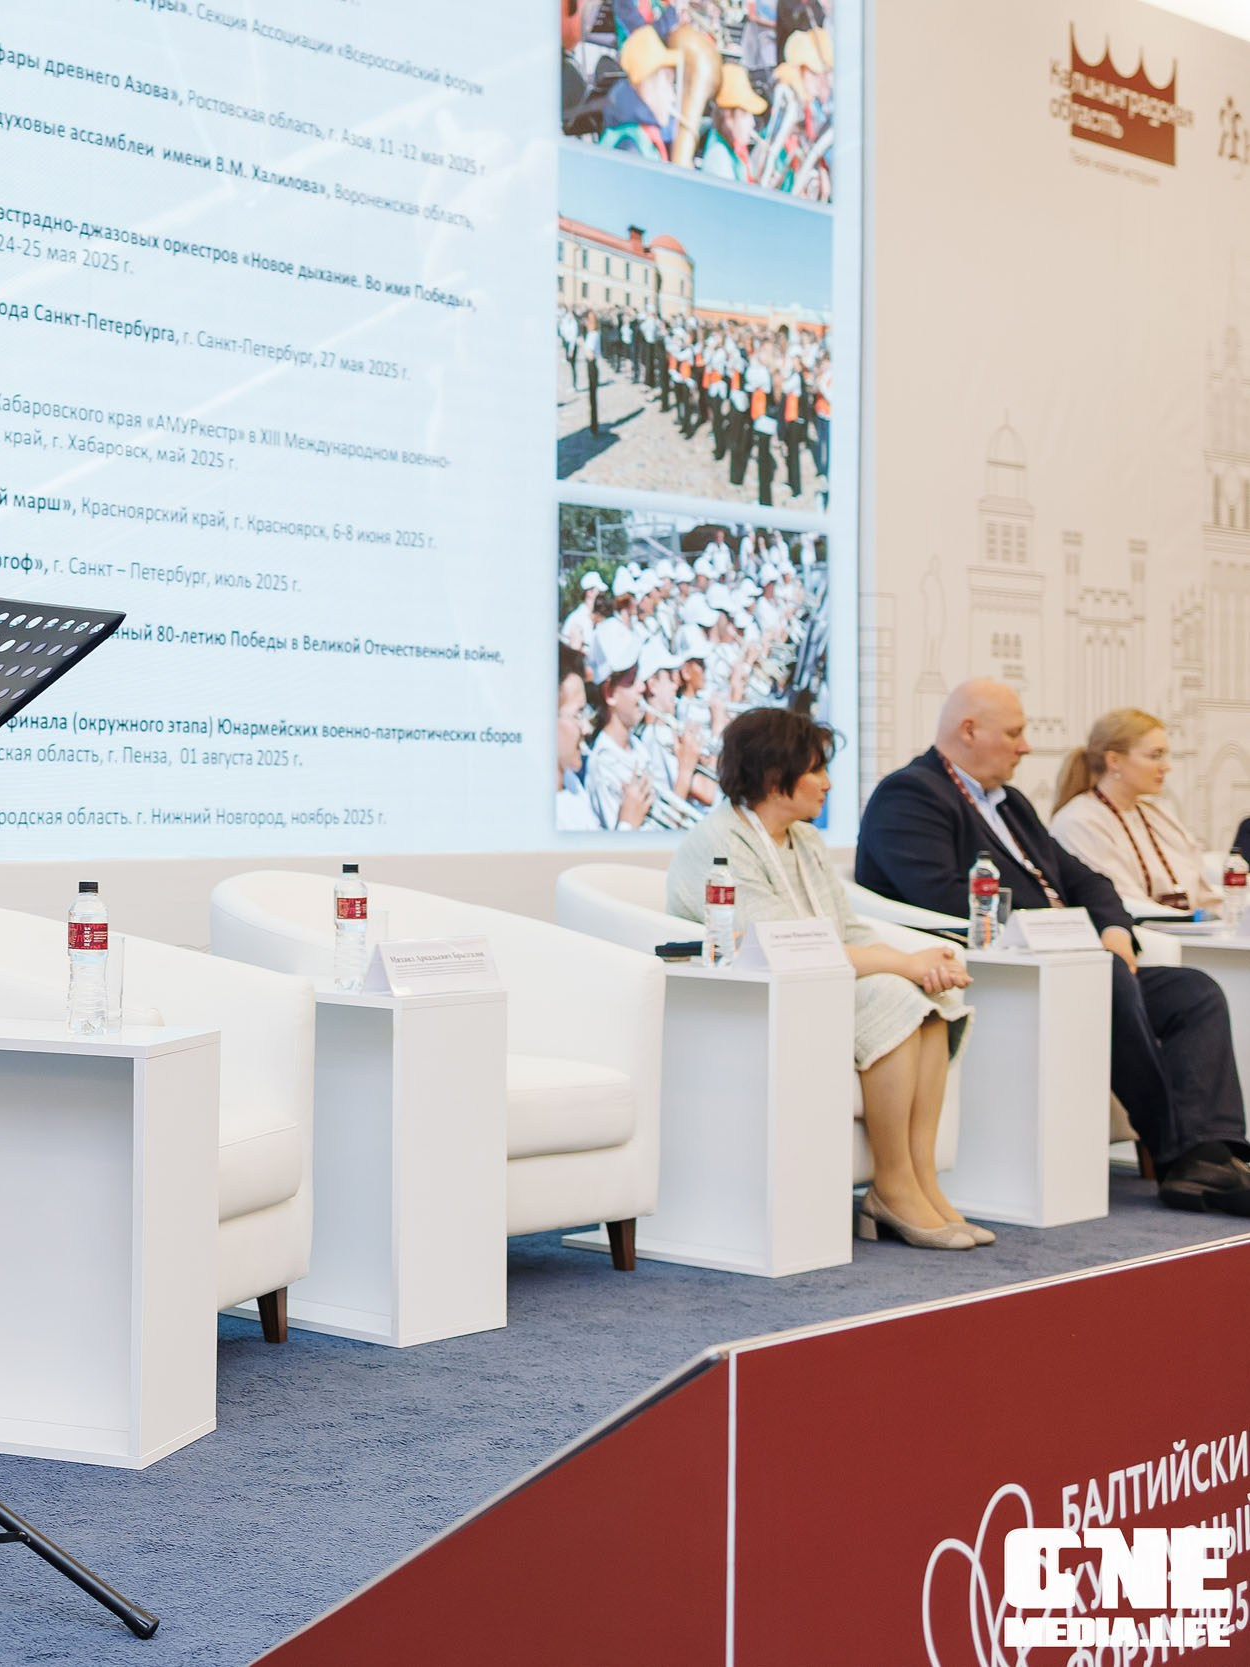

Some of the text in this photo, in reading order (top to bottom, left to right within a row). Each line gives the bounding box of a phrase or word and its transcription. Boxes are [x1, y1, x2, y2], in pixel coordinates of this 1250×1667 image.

[44, 59, 120, 89] древнего
[124, 74, 182, 107] Азова»,
[70, 126, 154, 157] ассамблеи
[163, 148, 211, 170] имени
[47, 247, 76, 263] мая
[82, 249, 119, 273] 2025
[123, 259, 133, 275] г.
[163, 238, 238, 265] оркестров
[243, 251, 294, 276] «Новое
[298, 265, 361, 288] дыхание.
[365, 274, 382, 293] Во
[385, 282, 411, 297] имя
[34, 303, 178, 345] Санкт-Петербурга,
[183, 330, 193, 346] г.
[197, 329, 317, 369] Санкт-Петербург,
[320, 350, 336, 368] 27
[339, 357, 364, 373] мая
[368, 358, 399, 379] 2025
[401, 366, 412, 381] г.
[4, 429, 47, 450] край,
[52, 435, 63, 450] г.
[68, 434, 152, 463] Хабаровск,
[156, 447, 186, 463] май
[190, 448, 224, 469] 2025
[228, 456, 238, 471] г.
[108, 412, 142, 429] края
[249, 430, 256, 444] в
[260, 428, 280, 446] XIII
[285, 431, 402, 463] Международном
[400, 450, 451, 469] военно-
[14, 494, 76, 515] марш»,
[81, 496, 188, 524] Красноярский
[192, 510, 229, 531] край,
[234, 516, 244, 531] г.
[247, 515, 329, 541] Красноярск,
[332, 523, 354, 542] 6-8
[357, 530, 391, 545] июня
[395, 529, 428, 549] 2025
[427, 536, 437, 549] г.
[53, 559, 63, 574] г.
[69, 556, 113, 577] Санкт
[131, 561, 210, 588] Петербург,
[214, 573, 252, 589] июль
[256, 572, 288, 592] 2025
[292, 579, 301, 593] г.
[157, 624, 226, 646] 80-летию
[231, 629, 287, 651] Победы
[291, 637, 299, 651] в
[303, 634, 364, 654] Великой
[364, 638, 461, 660] Отечественной
[464, 645, 504, 664] войне,
[73, 712, 164, 736] (окружного
[168, 716, 213, 737] этапа)
[218, 717, 317, 739] Юнармейских
[322, 725, 476, 743] военно-патриотических
[479, 726, 522, 747] сборов
[37, 742, 103, 766] область,
[107, 749, 117, 764] г.
[123, 745, 171, 766] Пенза,
[180, 746, 198, 765] 01
[202, 751, 253, 769] августа
[256, 749, 289, 767] 2025
[293, 753, 303, 767] г.
[67, 806, 132, 826] область.
[136, 810, 147, 825] г.
[151, 807, 211, 825] Нижний
[216, 808, 287, 828] Новгород,
[291, 806, 340, 828] ноябрь
[343, 808, 374, 826] 2025
[378, 811, 388, 825] г.
